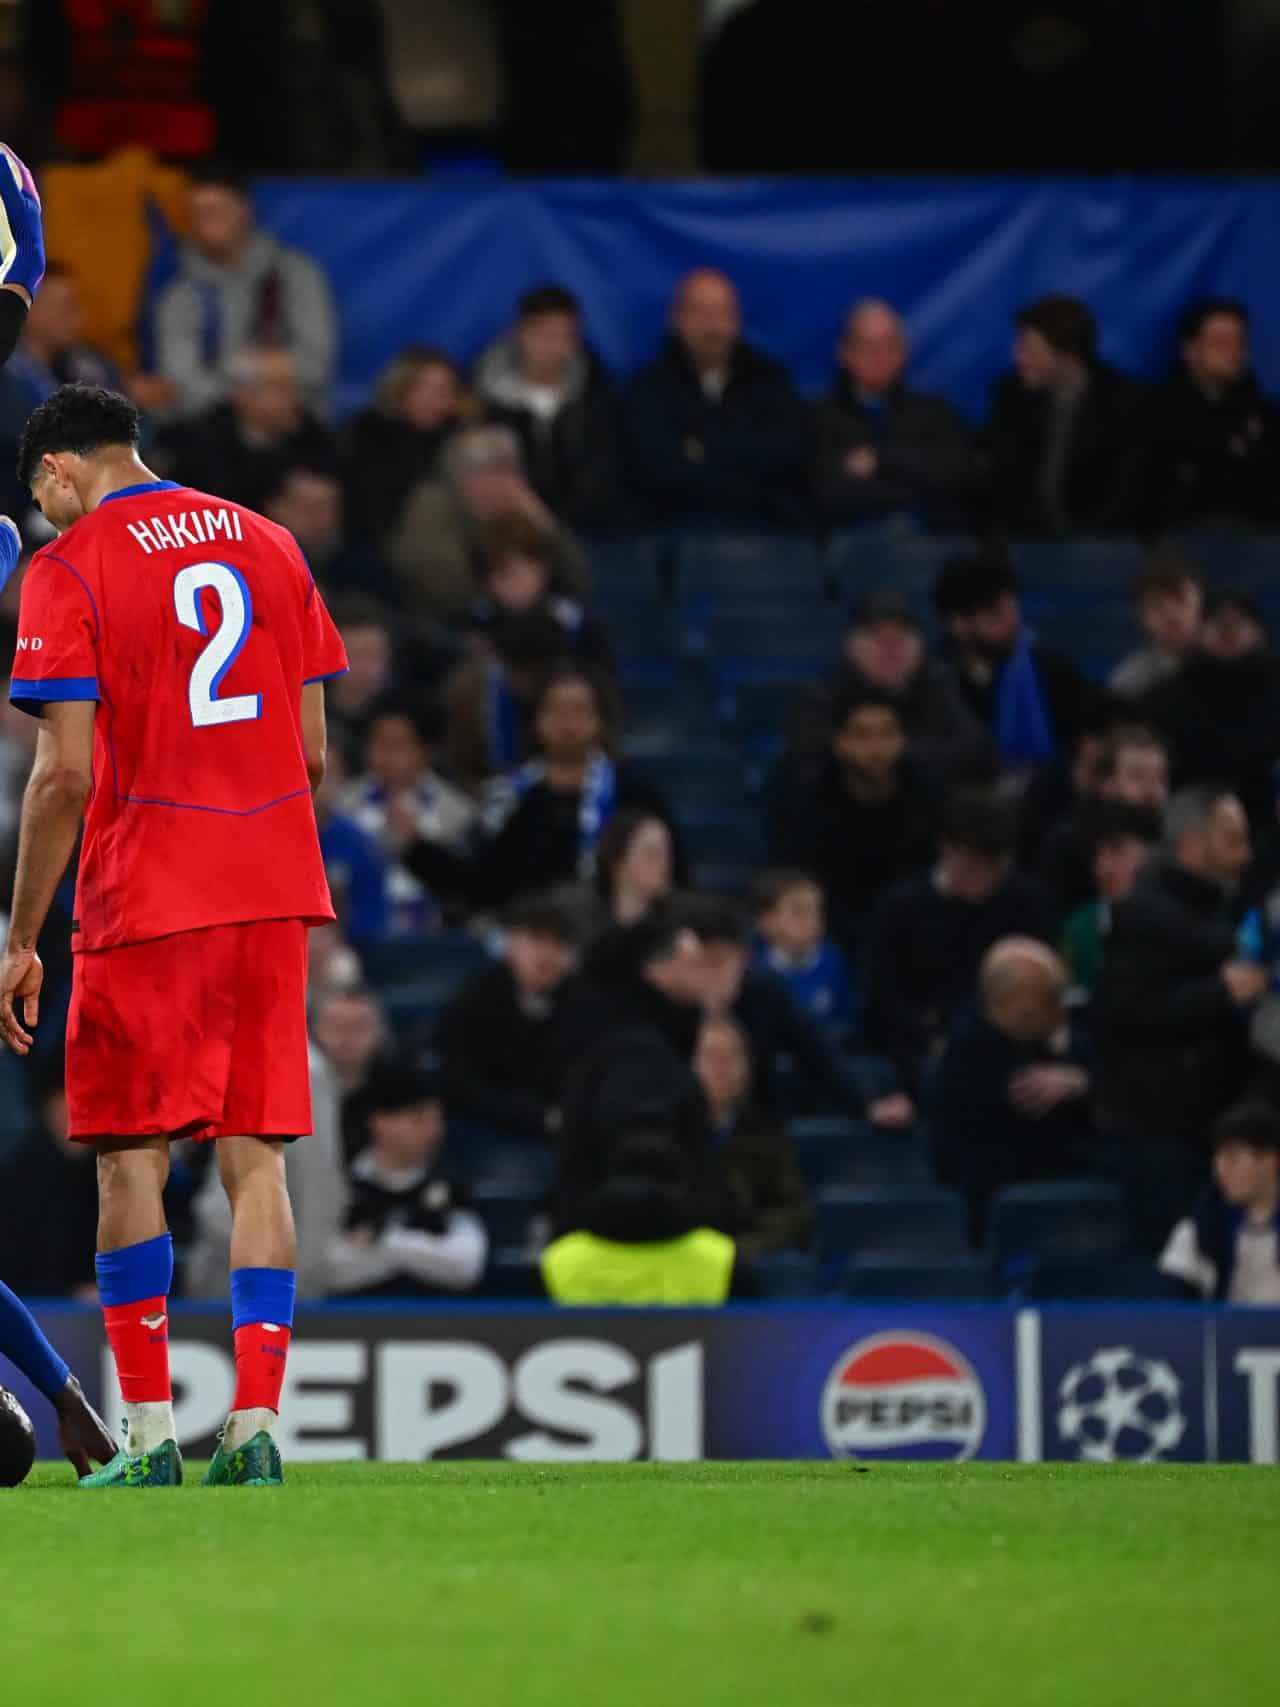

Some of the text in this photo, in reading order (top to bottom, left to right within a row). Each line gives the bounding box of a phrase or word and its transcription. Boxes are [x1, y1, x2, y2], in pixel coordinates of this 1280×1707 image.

[127, 509, 244, 554] HAKIMI
[173, 561, 262, 727] 2
[835, 1395, 973, 1431] PEPSI
